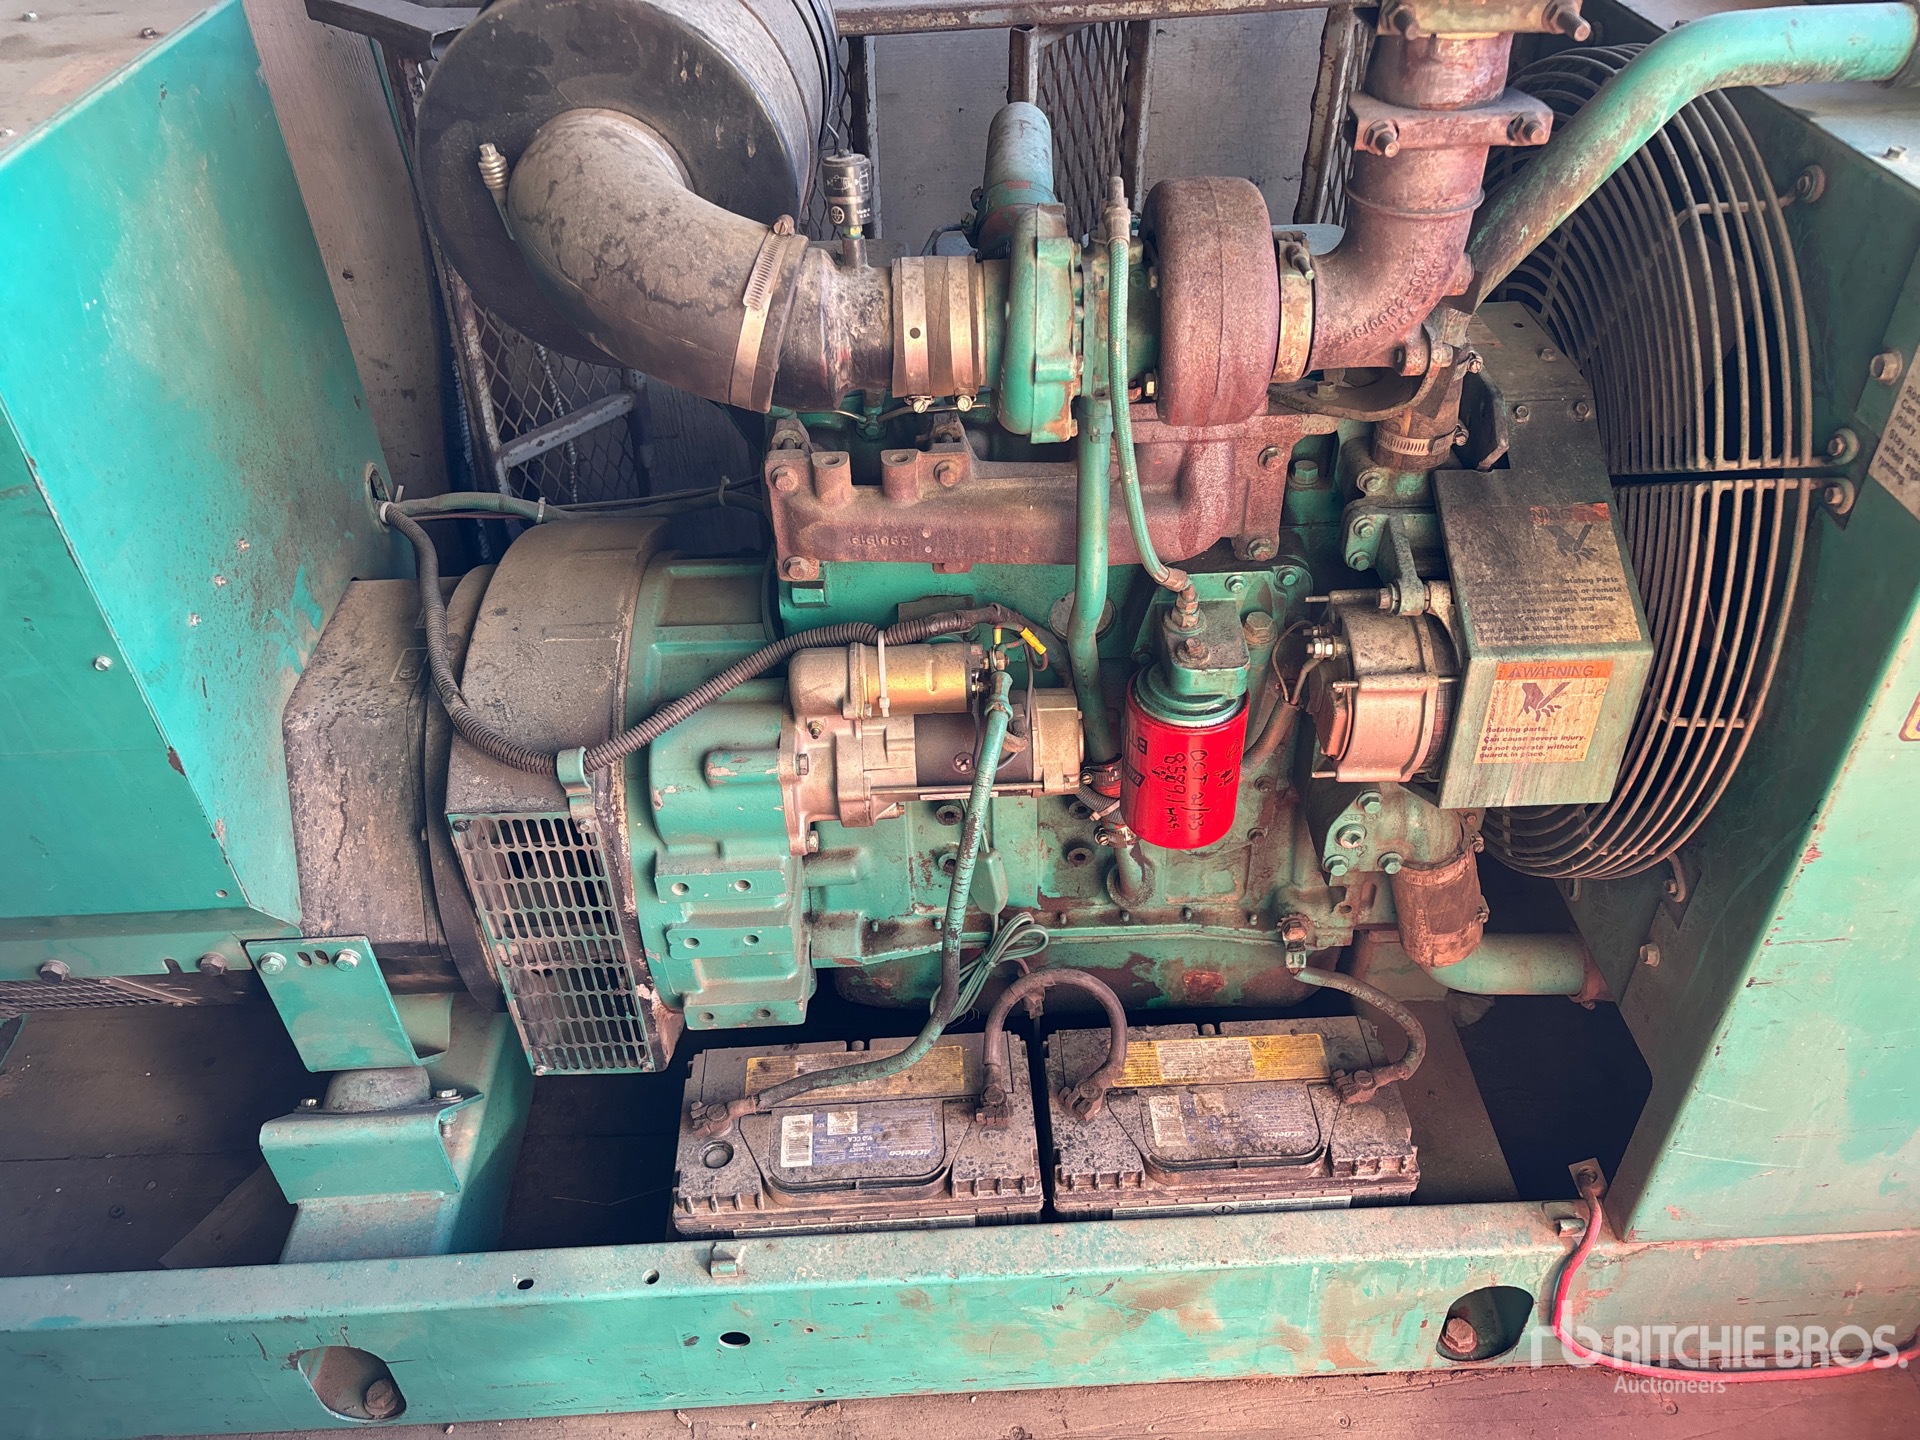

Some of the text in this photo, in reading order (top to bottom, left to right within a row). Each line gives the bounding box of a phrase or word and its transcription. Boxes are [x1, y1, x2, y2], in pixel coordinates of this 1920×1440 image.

[1888, 428, 1906, 451] Stay
[1596, 576, 1620, 584] Parts
[1523, 665, 1594, 678] WARNING
[1486, 726, 1549, 734] Rotating parts.
[1560, 734, 1587, 742] injury.
[1494, 744, 1510, 752] not
[1479, 751, 1508, 760] guards
[1510, 750, 1518, 758] in
[1190, 749, 1209, 786] OCT
[888, 1148, 932, 1157] ACDelco
